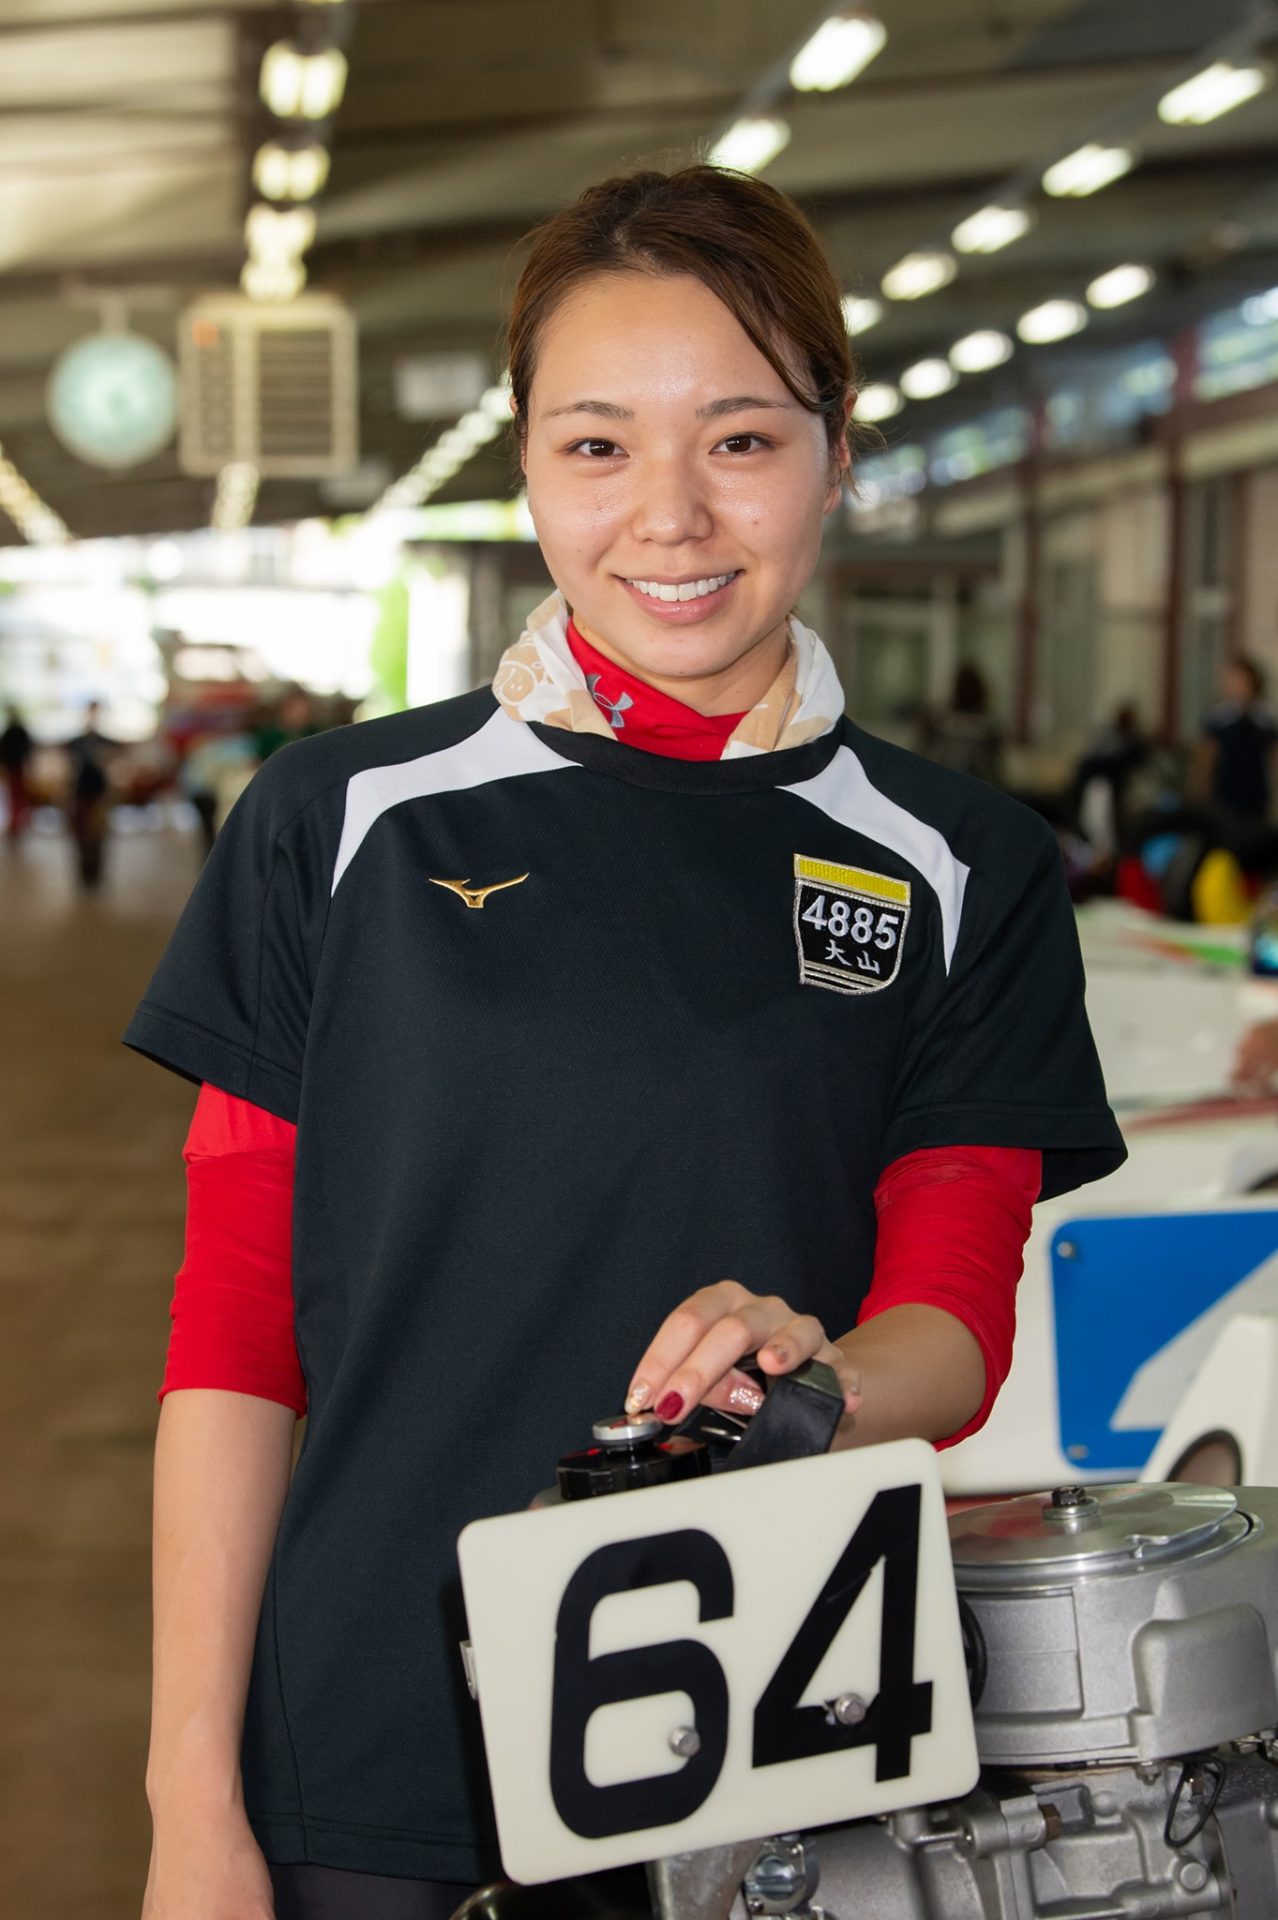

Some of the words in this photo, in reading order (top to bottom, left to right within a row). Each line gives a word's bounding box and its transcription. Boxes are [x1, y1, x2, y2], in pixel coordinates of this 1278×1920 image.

[802, 895, 899, 950] 4885
[825, 939, 880, 974] 大山
[549, 1484, 933, 1839] 64
